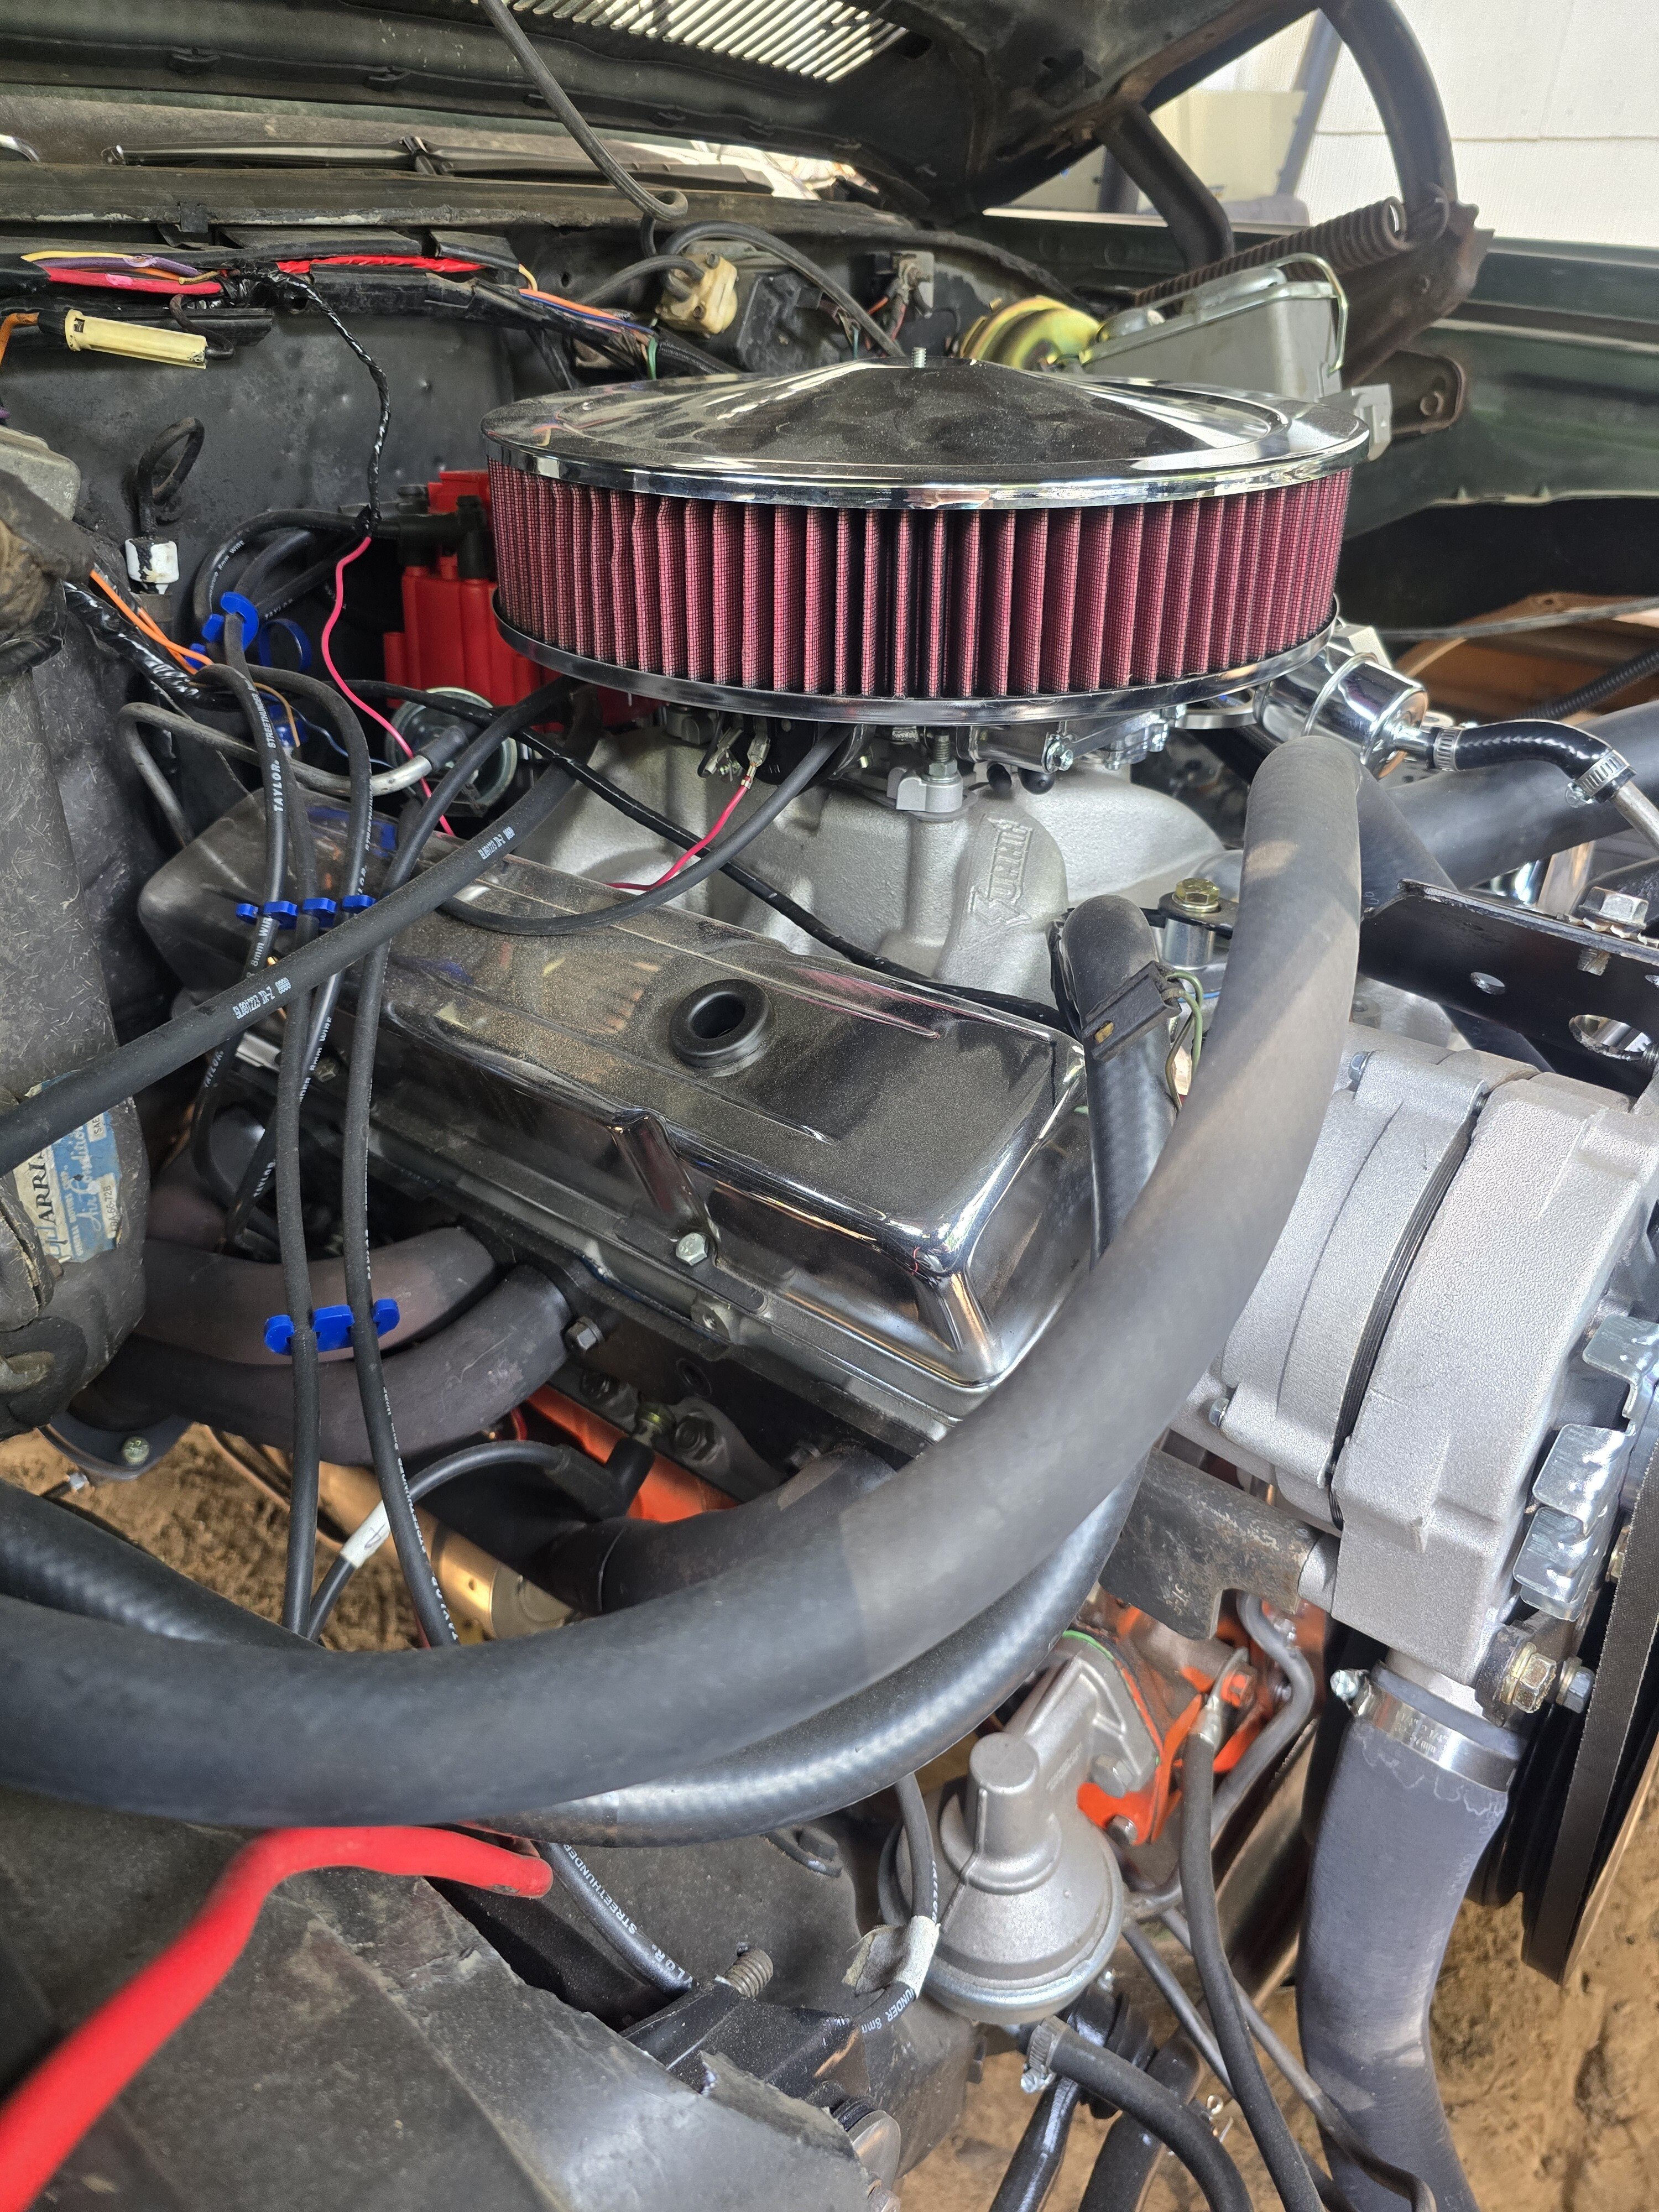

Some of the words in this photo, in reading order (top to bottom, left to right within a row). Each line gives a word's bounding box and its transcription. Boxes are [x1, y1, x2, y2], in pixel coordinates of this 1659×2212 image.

[251, 693, 276, 749] STREETHUNDER
[251, 942, 265, 967] 8mm
[29, 1150, 71, 1259] HARRI
